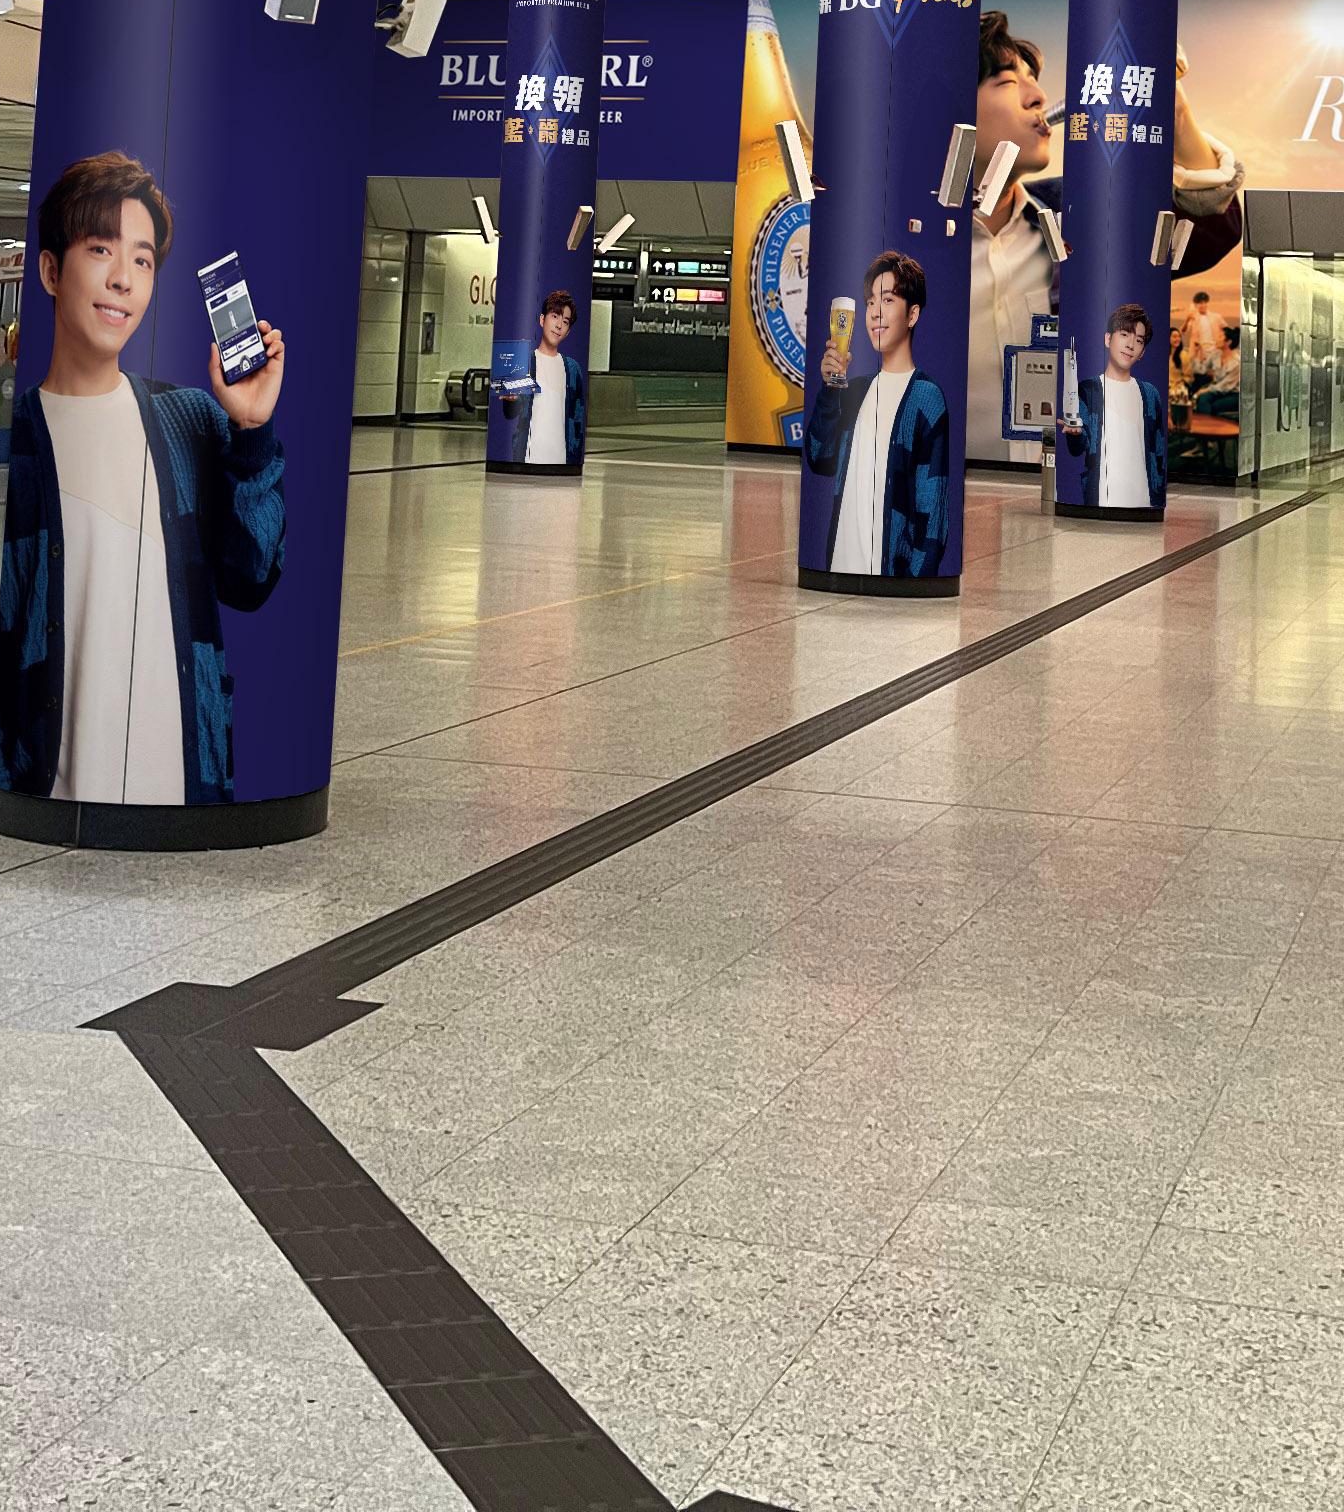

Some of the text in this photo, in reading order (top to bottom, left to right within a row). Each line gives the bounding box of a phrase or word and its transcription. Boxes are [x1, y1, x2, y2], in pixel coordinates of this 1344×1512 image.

[439, 55, 506, 86] BLU
[1079, 63, 1156, 107] 換領
[514, 74, 585, 114] 換領
[452, 109, 623, 123] IMPORT EER
[765, 211, 801, 284] PILSENER
